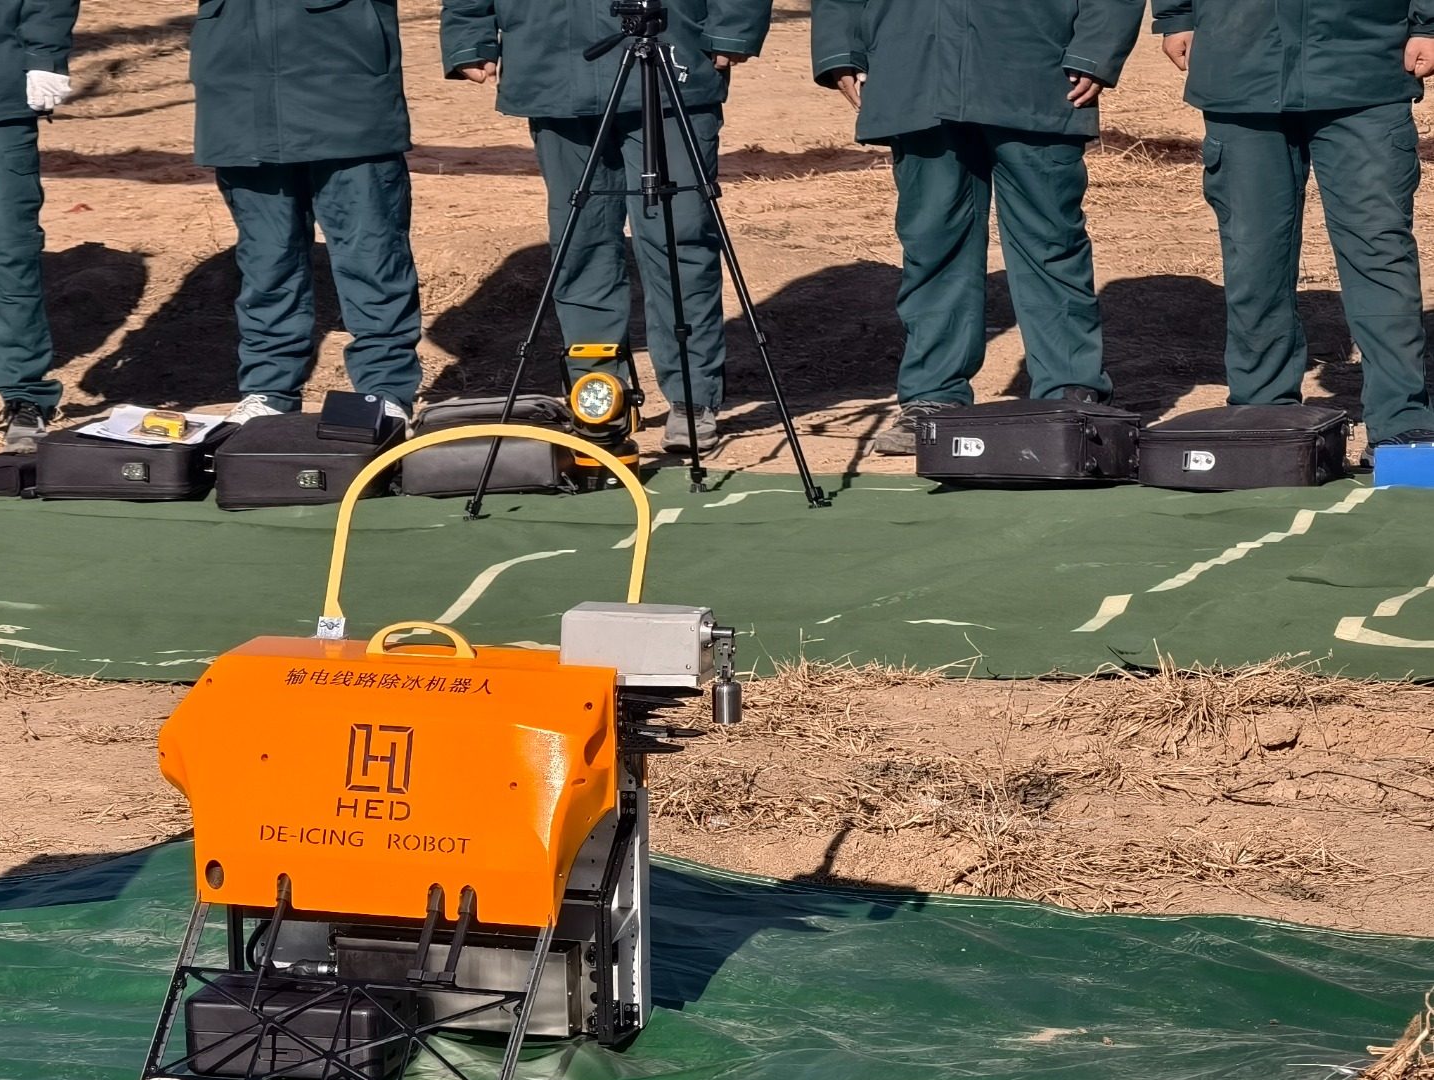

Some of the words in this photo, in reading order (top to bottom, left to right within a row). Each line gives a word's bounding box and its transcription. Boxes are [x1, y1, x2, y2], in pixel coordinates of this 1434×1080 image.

[285, 668, 493, 695] 输电线路除冰机器人
[337, 798, 411, 821] HED
[260, 825, 364, 848] DE-ICING
[387, 833, 471, 854] ROBOT
